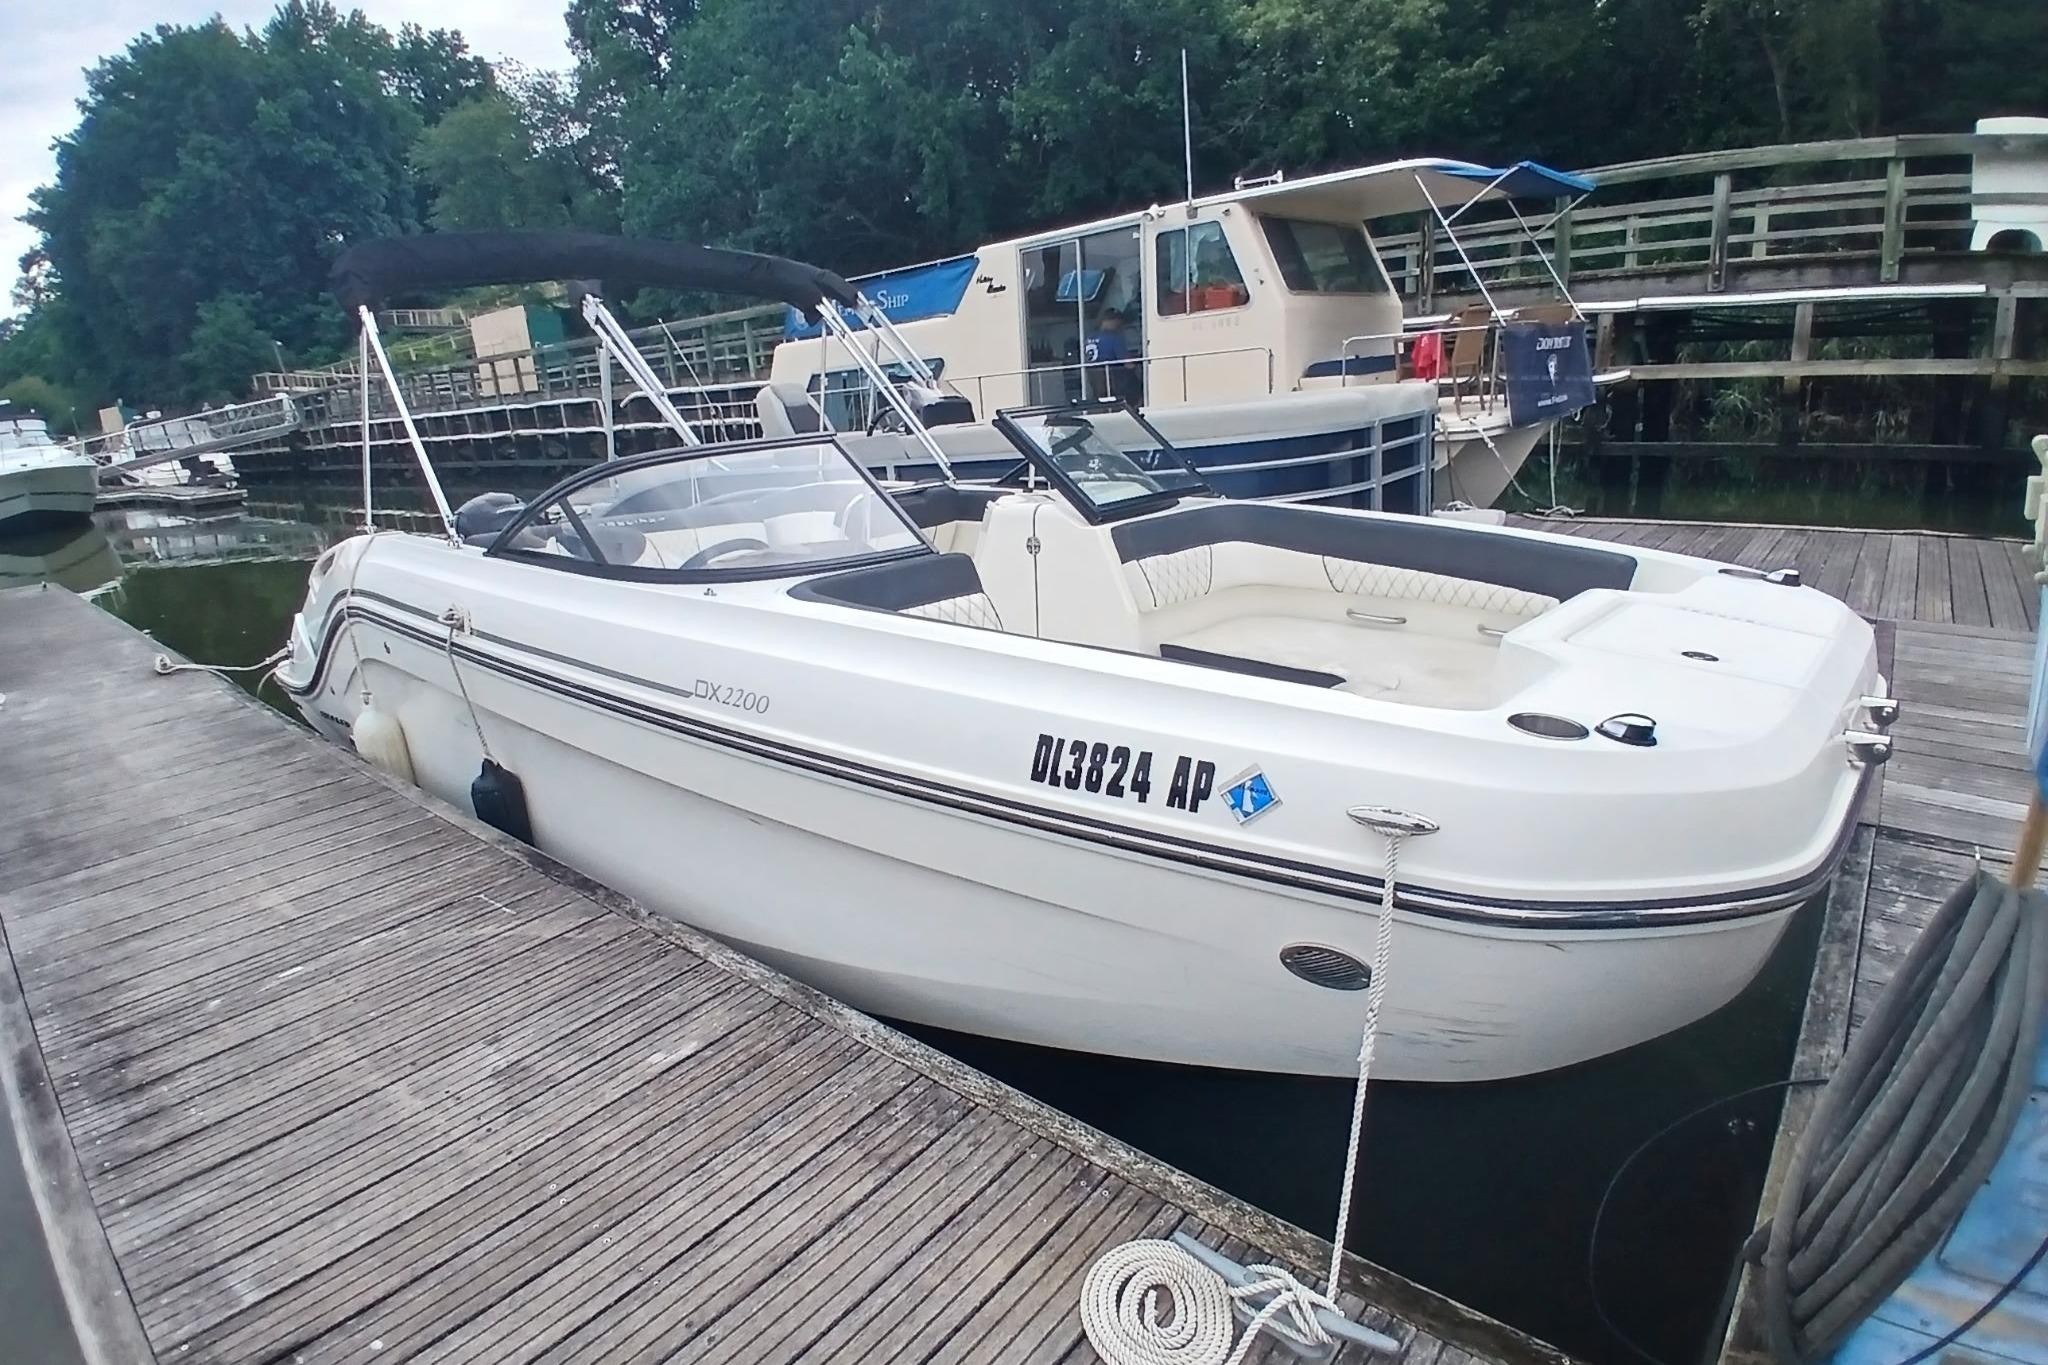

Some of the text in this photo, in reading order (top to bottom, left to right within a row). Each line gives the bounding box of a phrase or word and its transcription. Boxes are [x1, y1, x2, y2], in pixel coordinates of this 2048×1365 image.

[694, 679, 770, 714] DX2200
[1030, 733, 1216, 813] DL3824 AP
